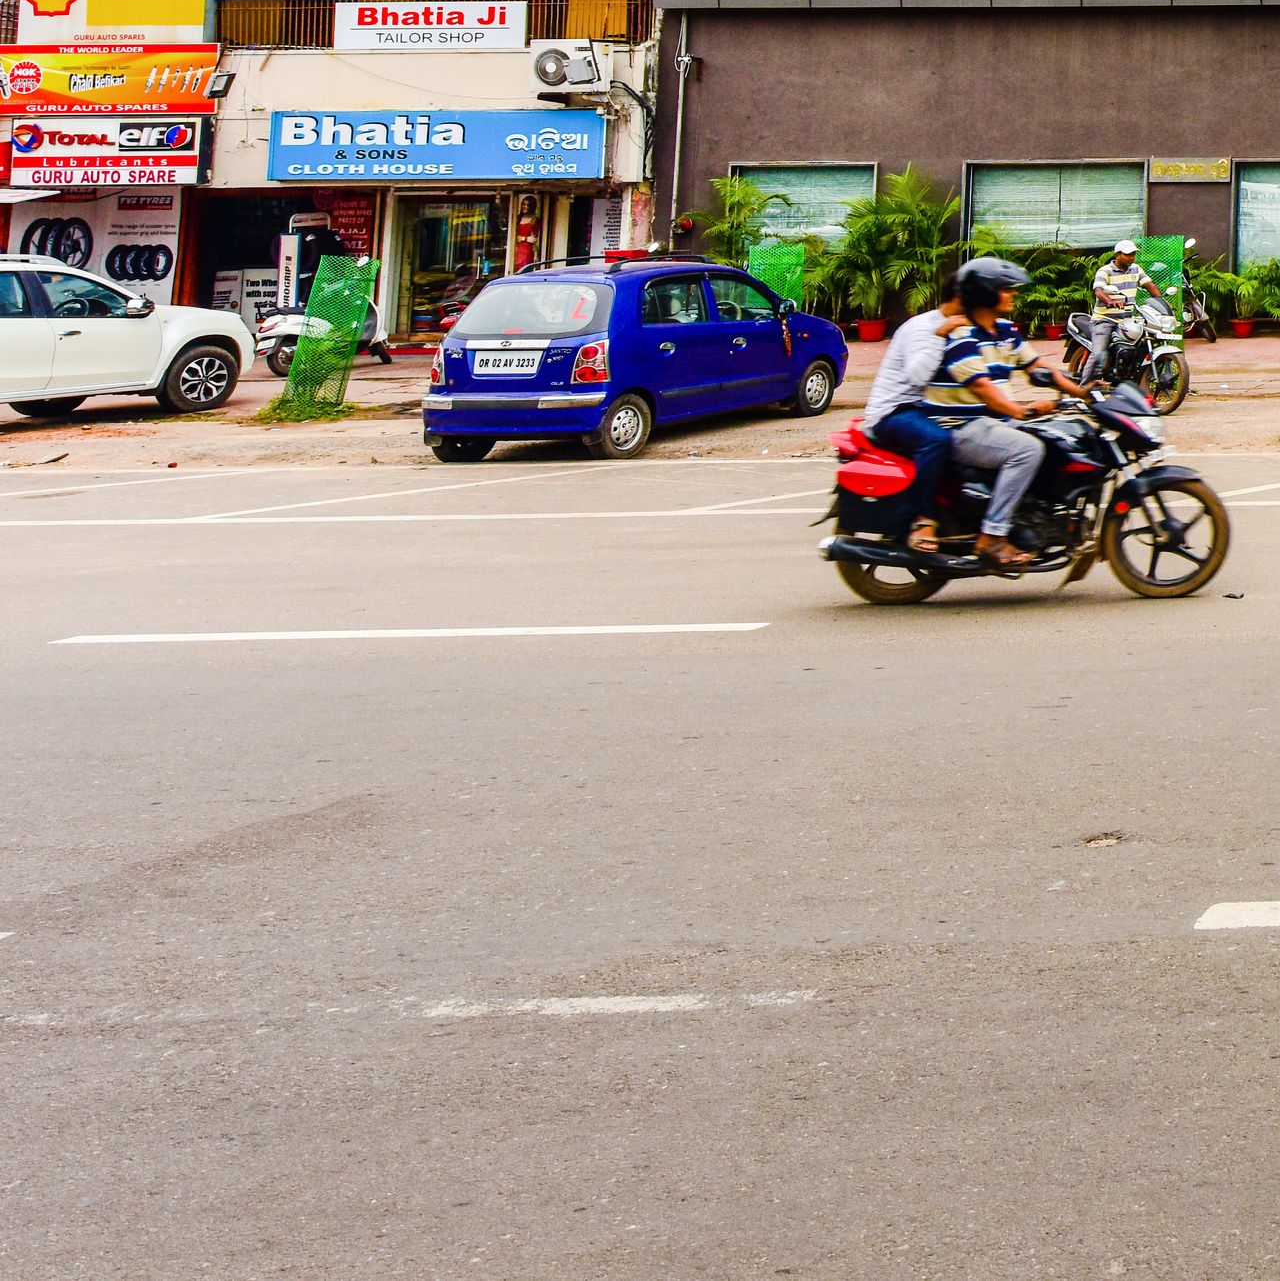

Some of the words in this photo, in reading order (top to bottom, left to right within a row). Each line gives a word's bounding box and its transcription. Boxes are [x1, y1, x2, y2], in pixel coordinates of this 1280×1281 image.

[357, 6, 464, 26] Bhatia
[477, 6, 507, 25] Ji
[376, 32, 433, 43] TAILOR
[438, 32, 485, 43] SHOP
[14, 68, 37, 76] NGK
[25, 104, 67, 112] GURU
[115, 103, 168, 111] SPARES
[119, 125, 168, 147] elf
[280, 115, 466, 146] Bhatia
[505, 127, 589, 152] ଭାଟିଆ
[334, 149, 348, 160] &
[355, 149, 408, 160] SONS
[43, 157, 168, 167] Lubricants
[287, 164, 365, 175] CLOTH
[372, 164, 454, 175] HOUSE
[32, 171, 73, 184] GURU
[81, 170, 121, 184] AUTO
[128, 170, 176, 183] SPARE
[283, 266, 291, 307] UROGRIP
[479, 358, 489, 367] OR
[492, 358, 501, 367] 02
[503, 358, 515, 367] AV
[515, 358, 535, 367] 3233
